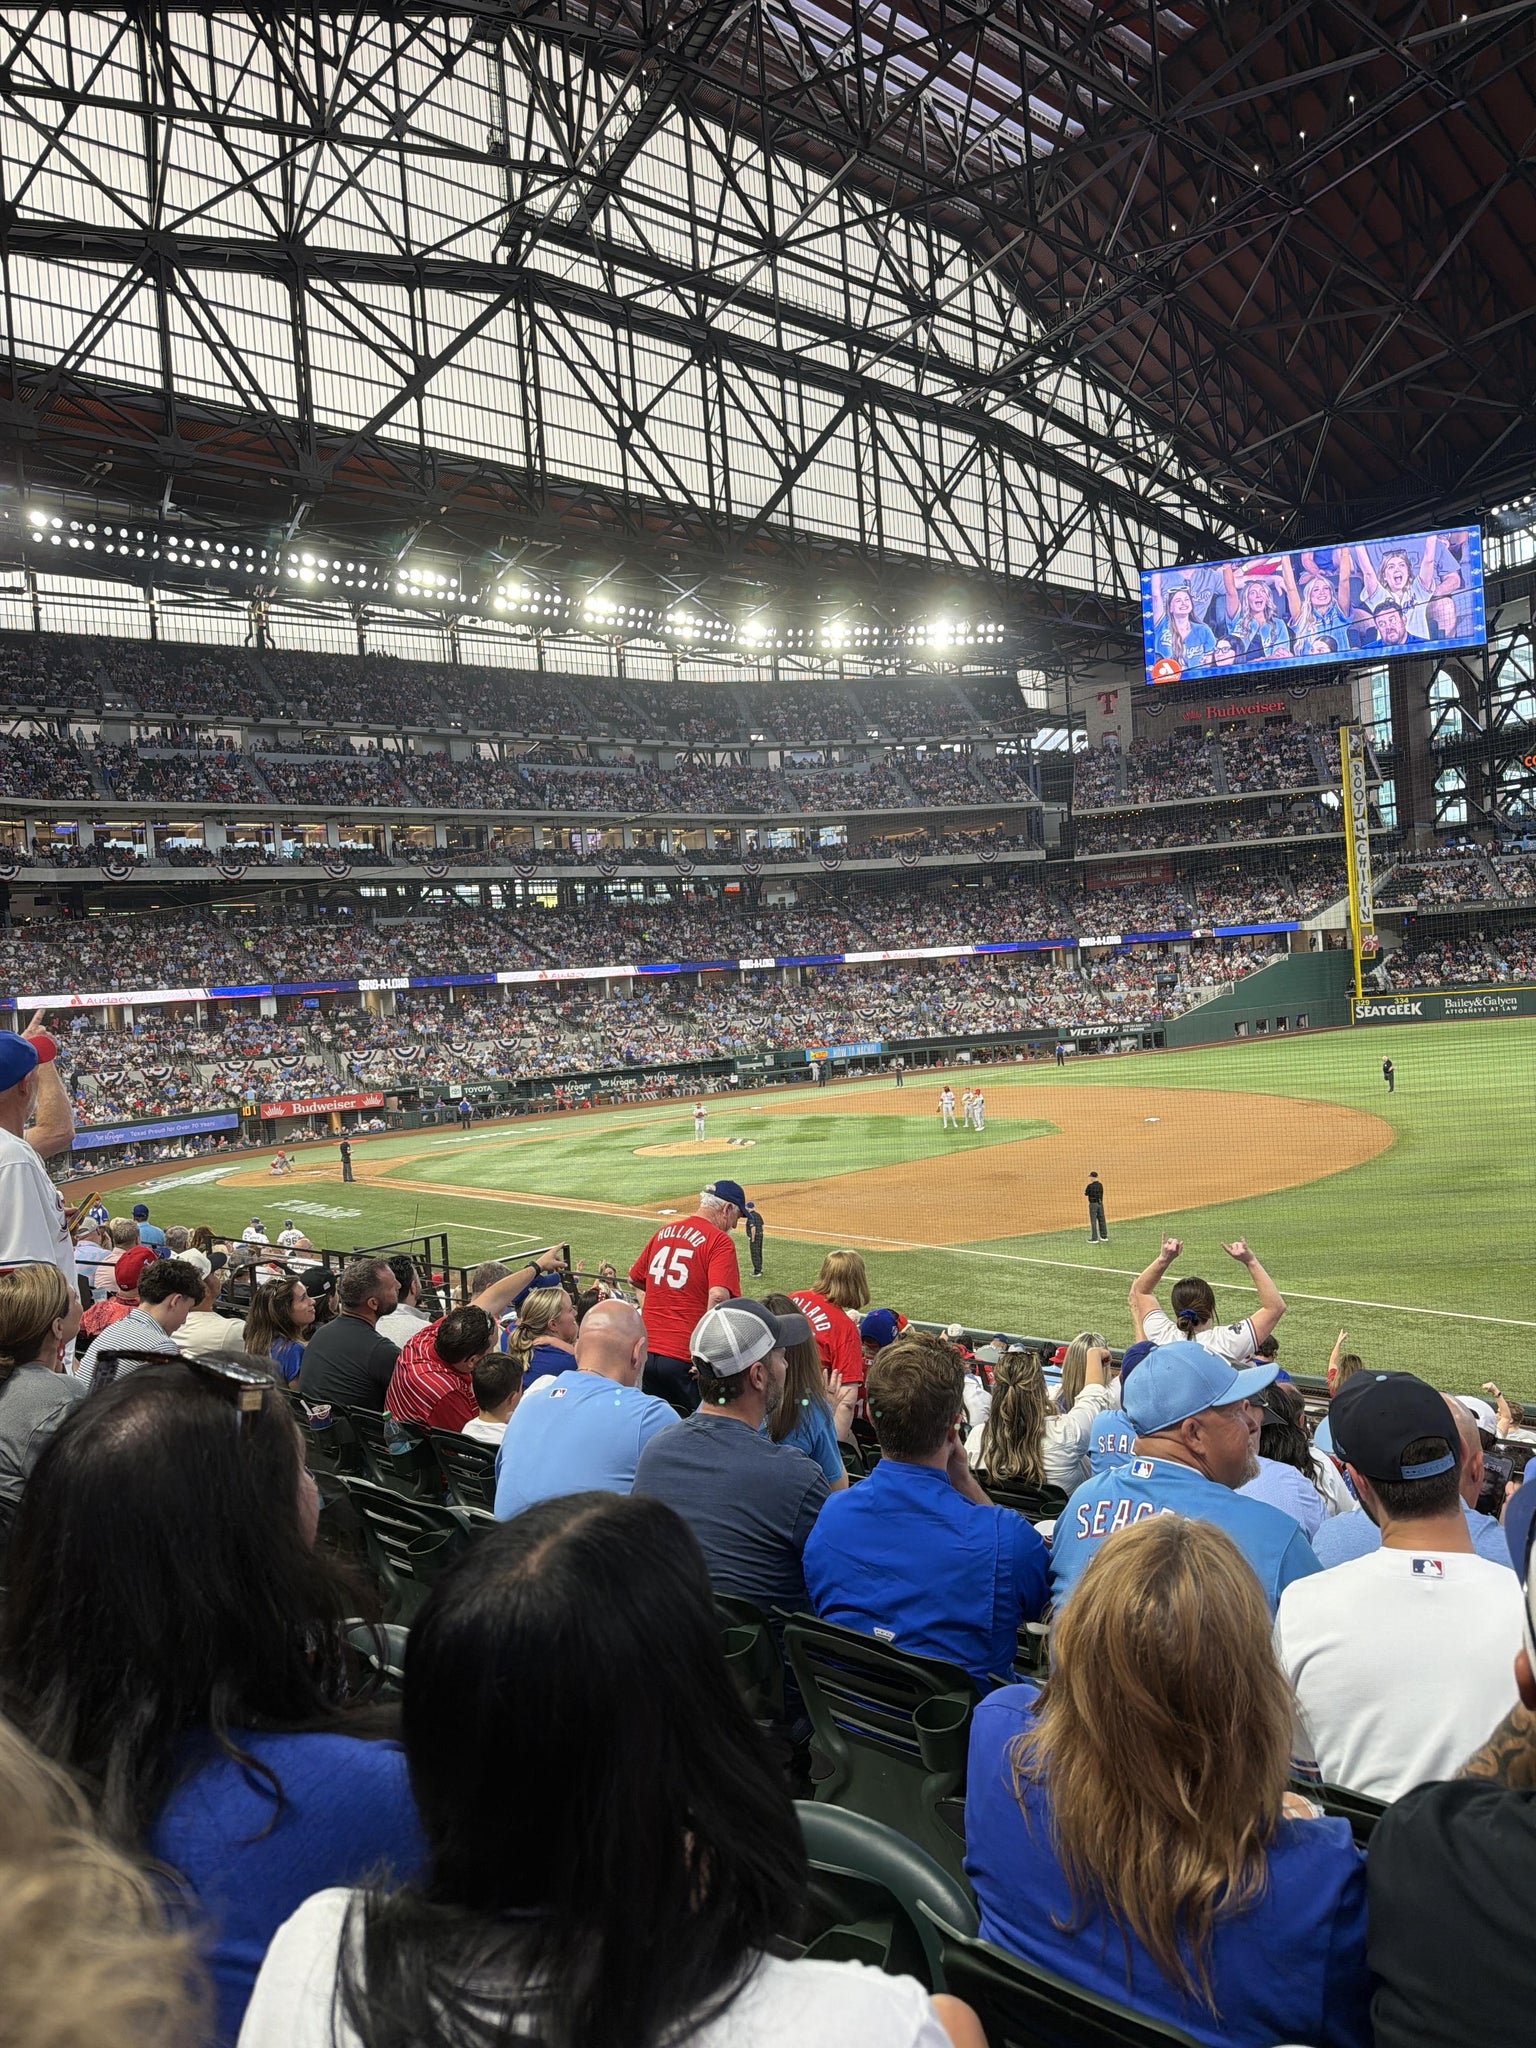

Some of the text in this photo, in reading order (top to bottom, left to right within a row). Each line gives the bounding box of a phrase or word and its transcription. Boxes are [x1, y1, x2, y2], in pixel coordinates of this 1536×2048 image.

[1206, 701, 1284, 720] Budweiser
[1352, 763, 1371, 920] ROOT 4 CHIKIN
[1110, 871, 1147, 881] FOUNDATION
[1422, 905, 1447, 914] SHIFT
[1492, 900, 1518, 909] SHIFT
[358, 978, 409, 991] SING-A-LONG
[86, 996, 134, 1005] Audacy
[1444, 996, 1517, 1009] Bailey&Galyen
[1355, 1002, 1423, 1019] SEATGEEK
[1070, 1026, 1115, 1036] VICTORY
[565, 1080, 592, 1095] Kroger
[610, 1075, 637, 1087] Kroger
[464, 1085, 492, 1094] TOYOTA
[291, 1100, 356, 1114] Budweiser
[658, 1224, 707, 1248] HOLLAND
[649, 1246, 694, 1289] 45
